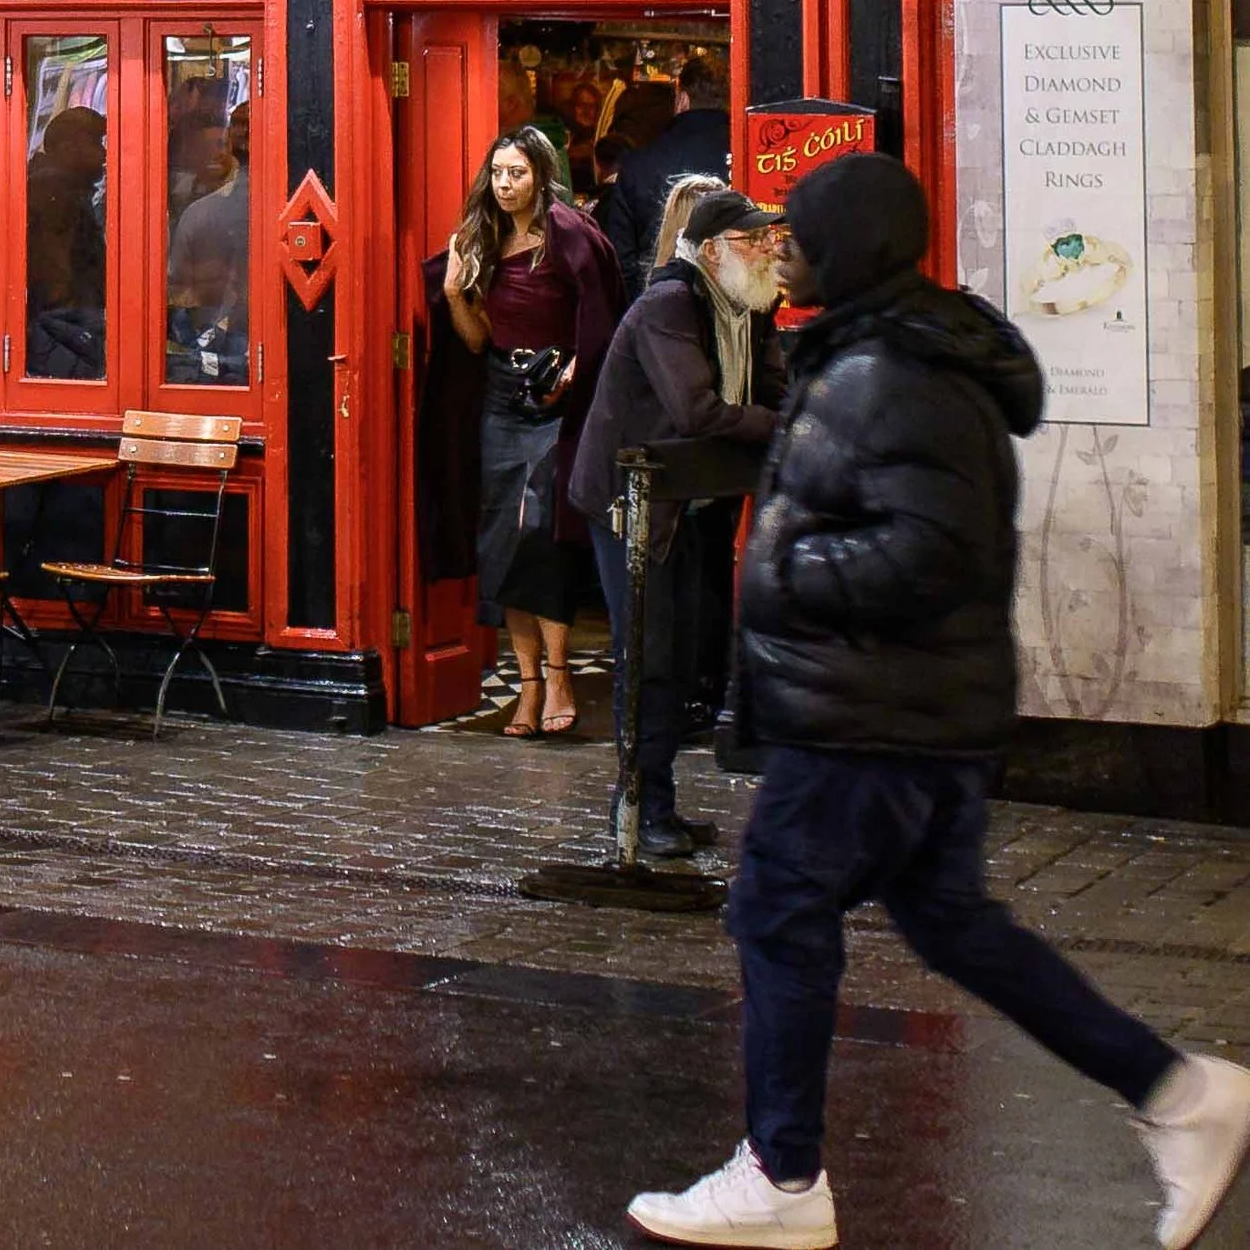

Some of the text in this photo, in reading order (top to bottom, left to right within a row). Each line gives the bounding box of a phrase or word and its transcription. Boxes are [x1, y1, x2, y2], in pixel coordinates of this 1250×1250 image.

[1024, 43, 1121, 60] EXCLUSIVE
[1024, 75, 1121, 92] DIAMOND
[1025, 107, 1120, 124] & GEMSET
[1019, 139, 1126, 157] CLADDAGH
[1045, 171, 1104, 188] RINGS
